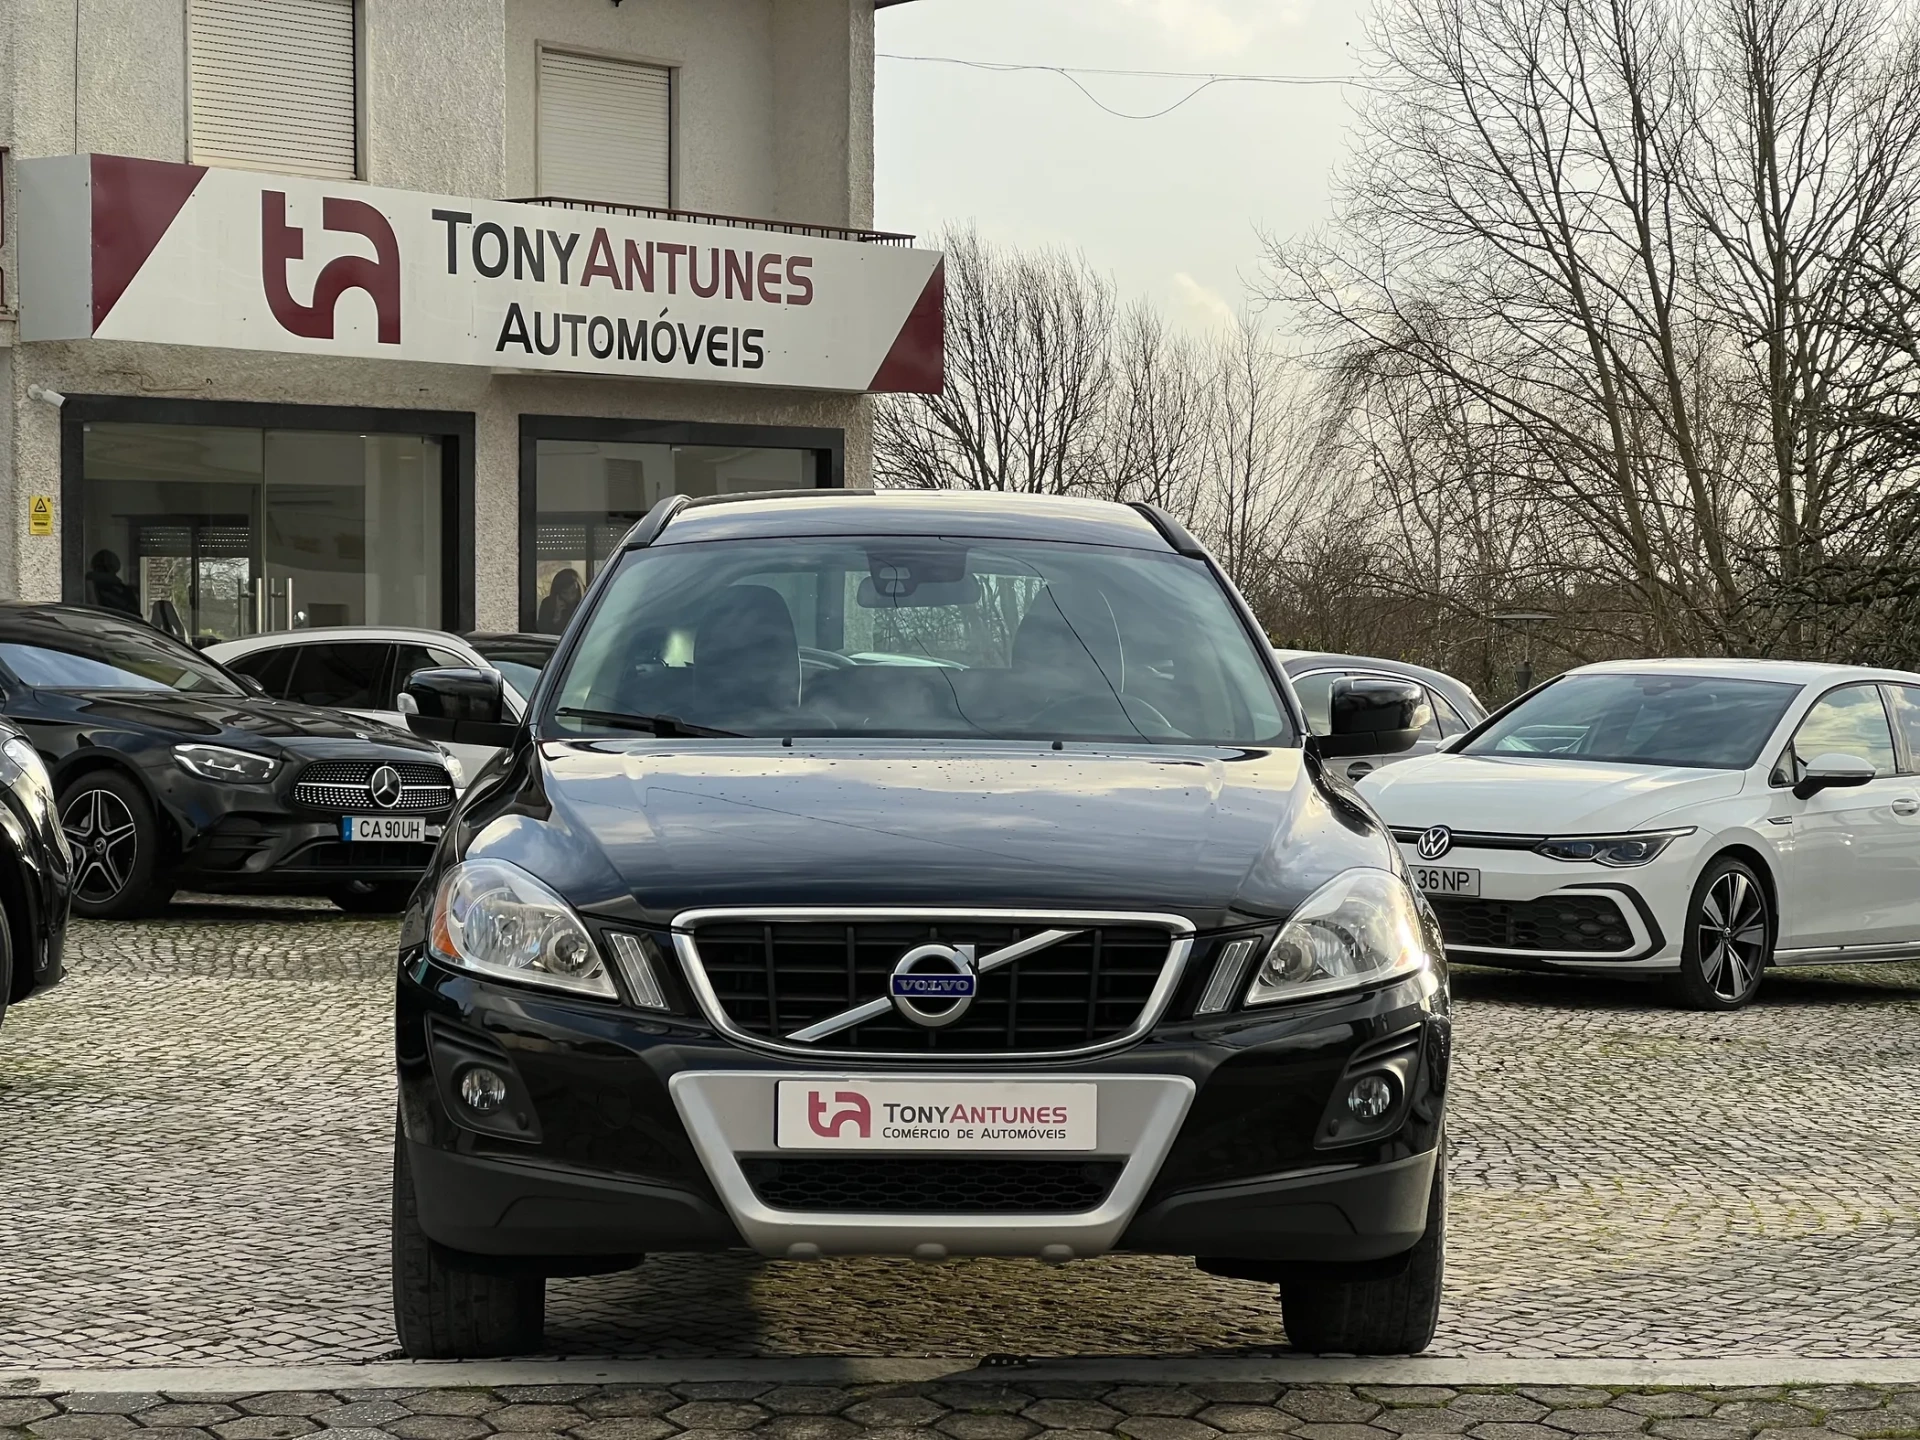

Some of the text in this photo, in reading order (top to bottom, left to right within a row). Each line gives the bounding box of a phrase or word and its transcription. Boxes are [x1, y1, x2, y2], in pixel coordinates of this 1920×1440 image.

[495, 302, 765, 370] AUTOMÓVEIS
[897, 979, 969, 991] VOLVO
[882, 1126, 1066, 1139] COMÉRCIO DE AUTOMÓVEIS
